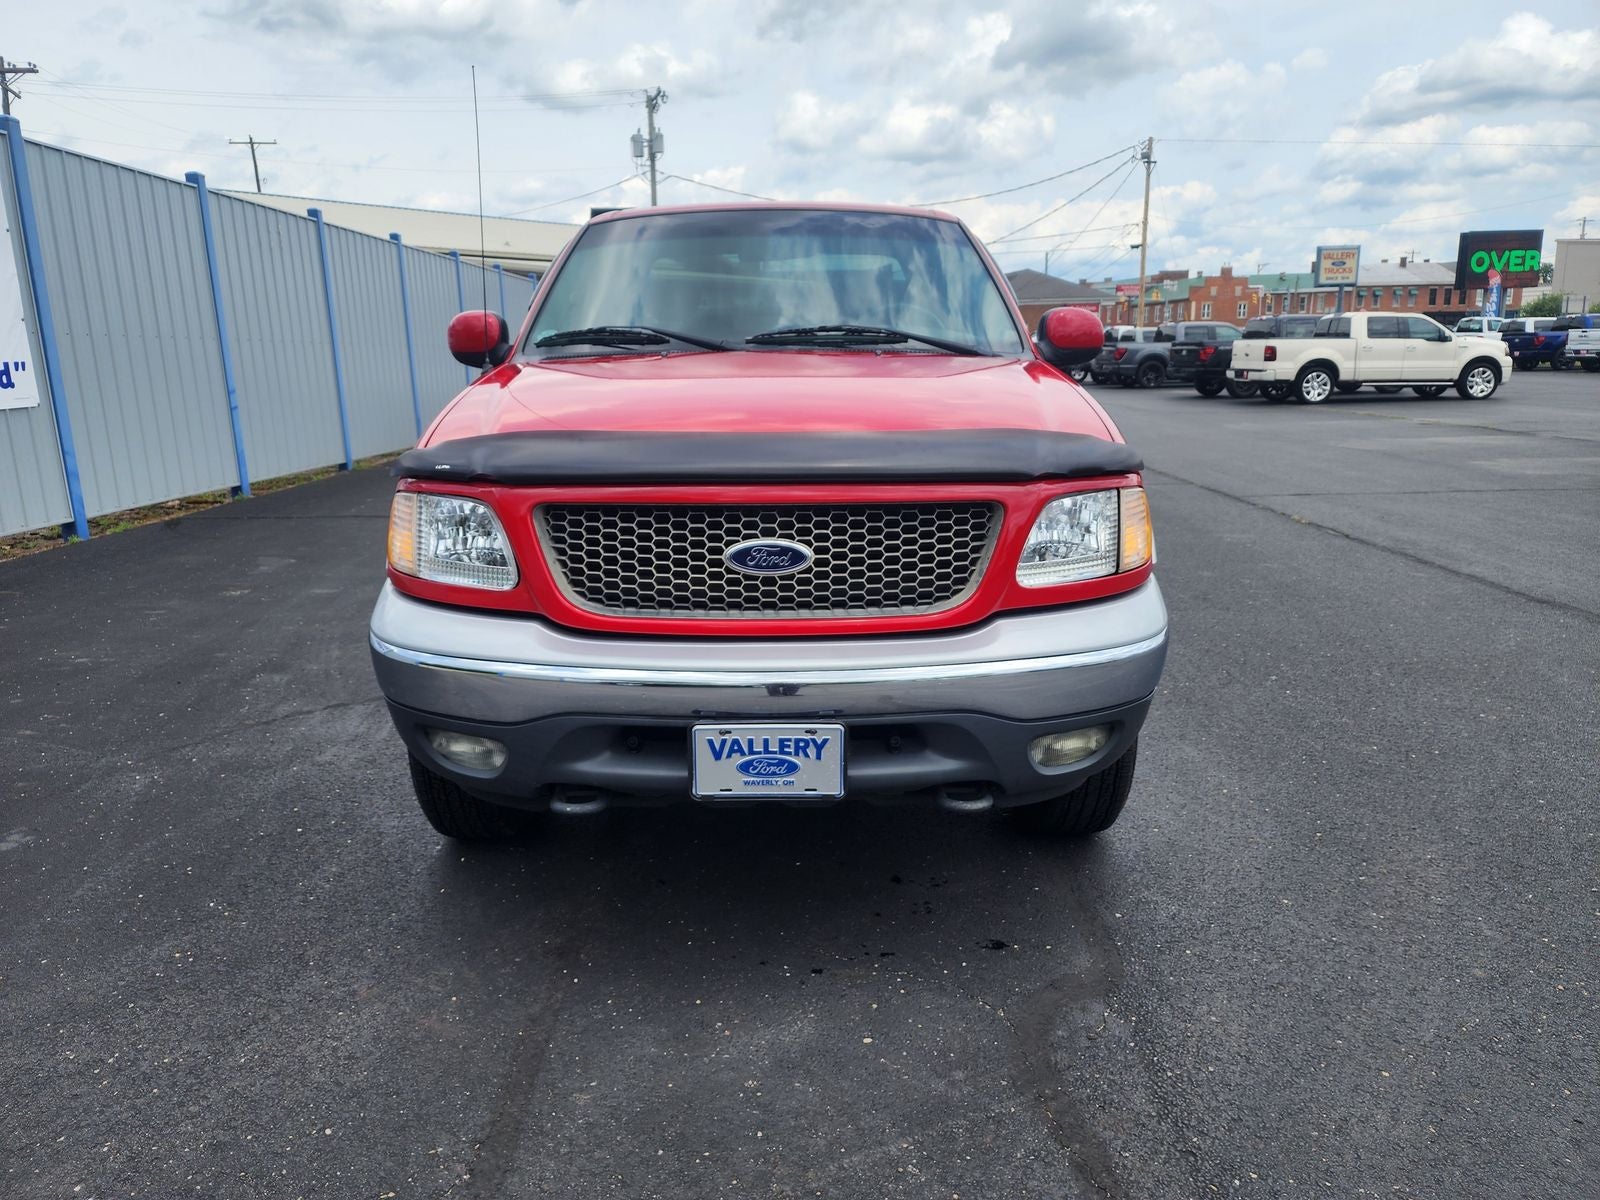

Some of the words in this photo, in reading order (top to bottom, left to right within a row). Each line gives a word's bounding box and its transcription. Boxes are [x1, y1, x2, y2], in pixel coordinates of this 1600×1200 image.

[1323, 251, 1355, 260] VALLERY
[1471, 250, 1540, 273] OVER
[746, 546, 792, 566] Ford
[706, 737, 830, 761] VALLERY
[749, 758, 788, 774] Ford
